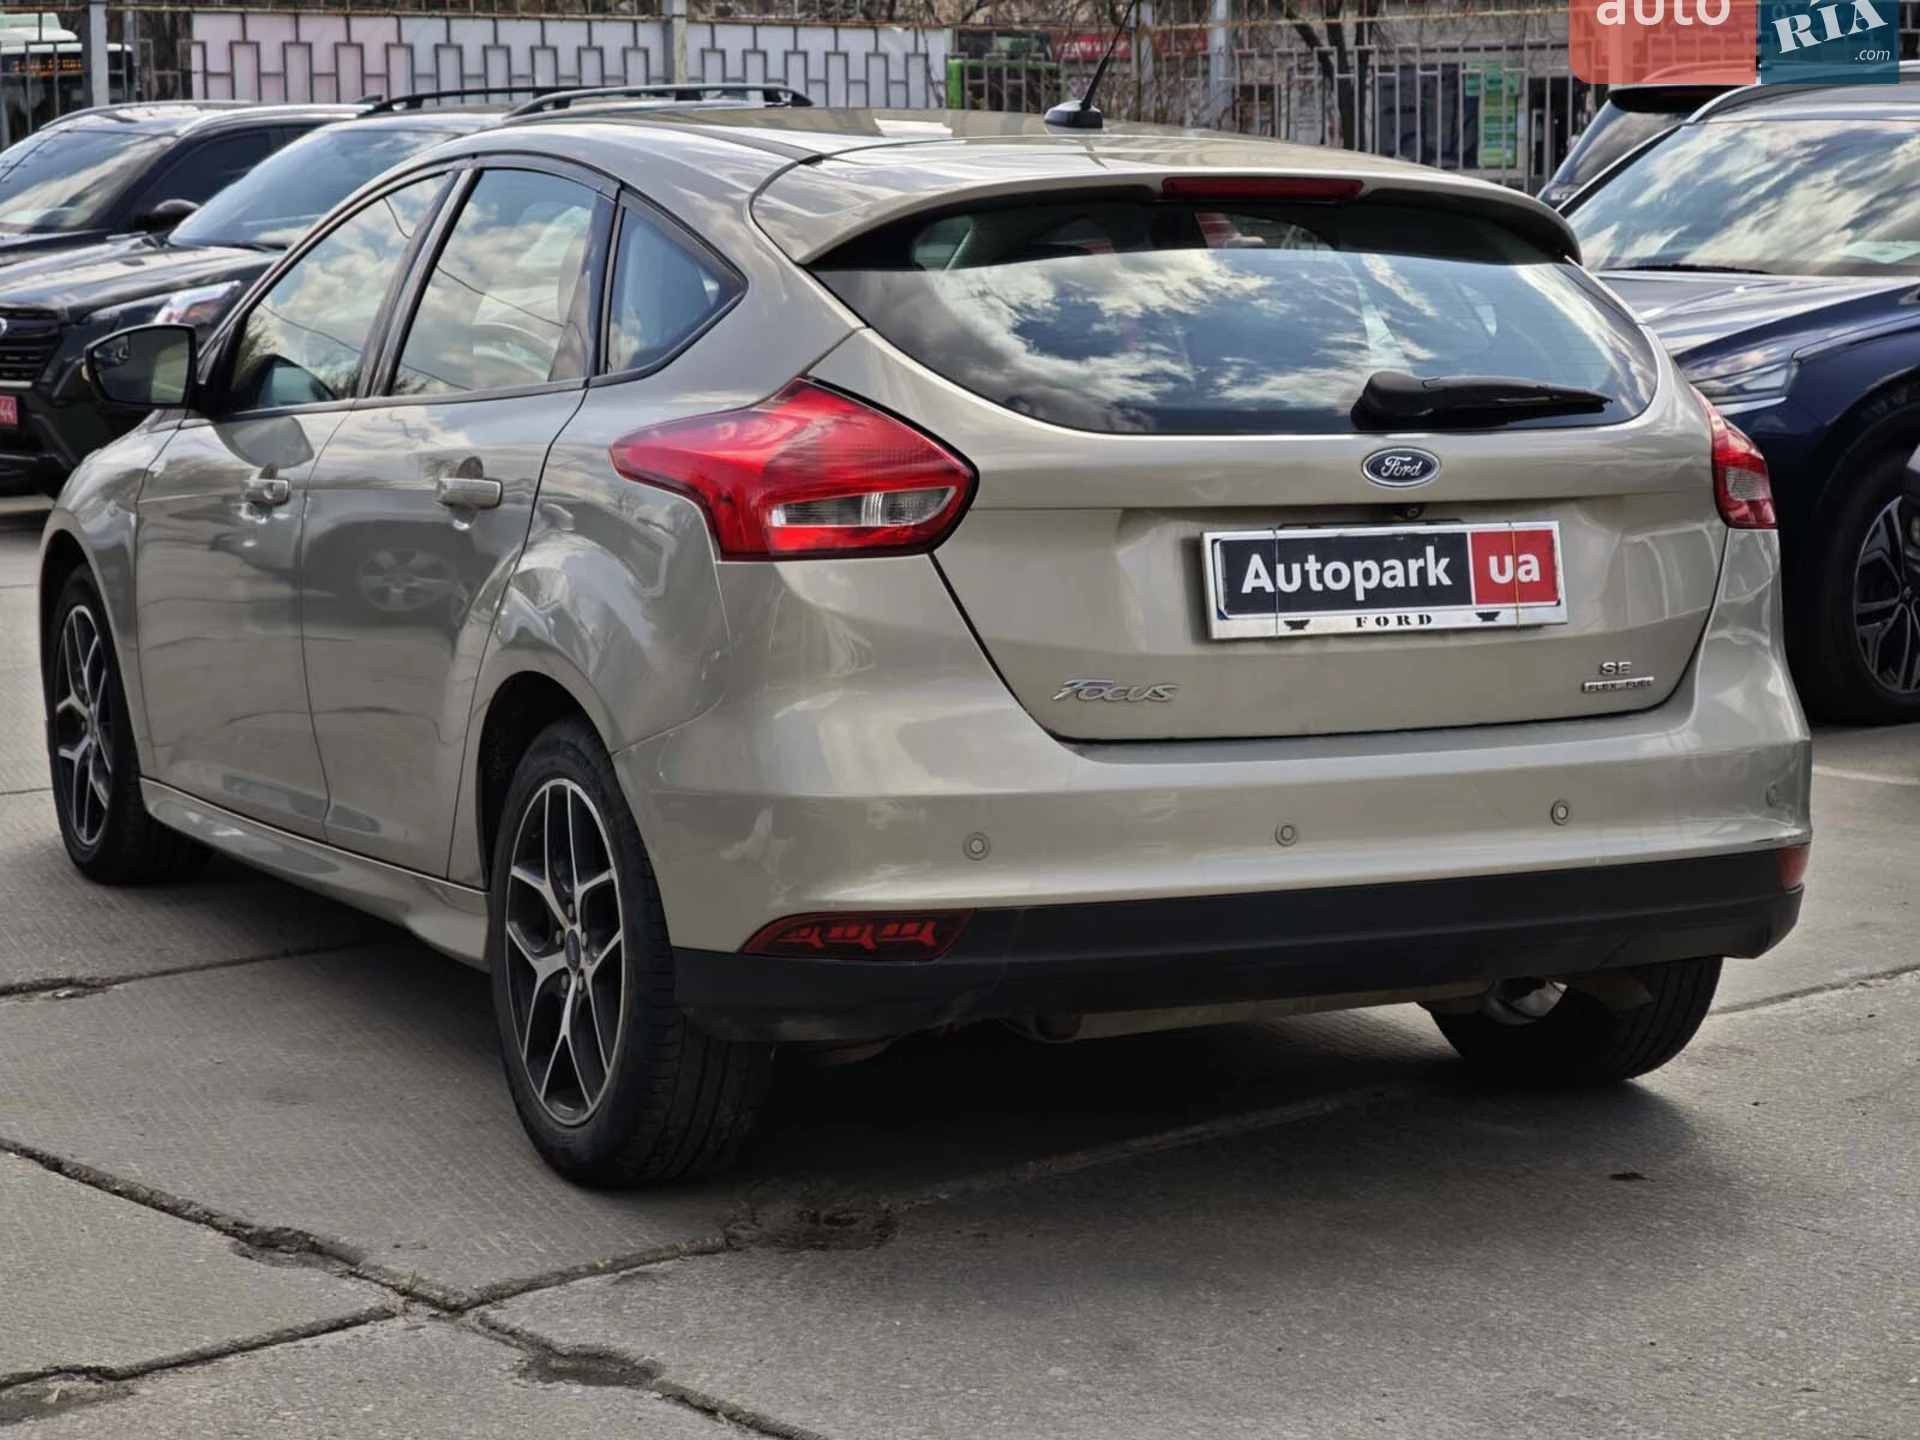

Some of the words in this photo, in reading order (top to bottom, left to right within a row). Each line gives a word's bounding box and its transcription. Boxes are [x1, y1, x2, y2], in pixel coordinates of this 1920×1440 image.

[1381, 456, 1423, 477] Ford
[1241, 545, 1453, 602] Autopark
[1488, 552, 1541, 584] ua
[1355, 614, 1433, 628] FORD
[1601, 661, 1632, 675] SE
[1053, 678, 1181, 702] Focus
